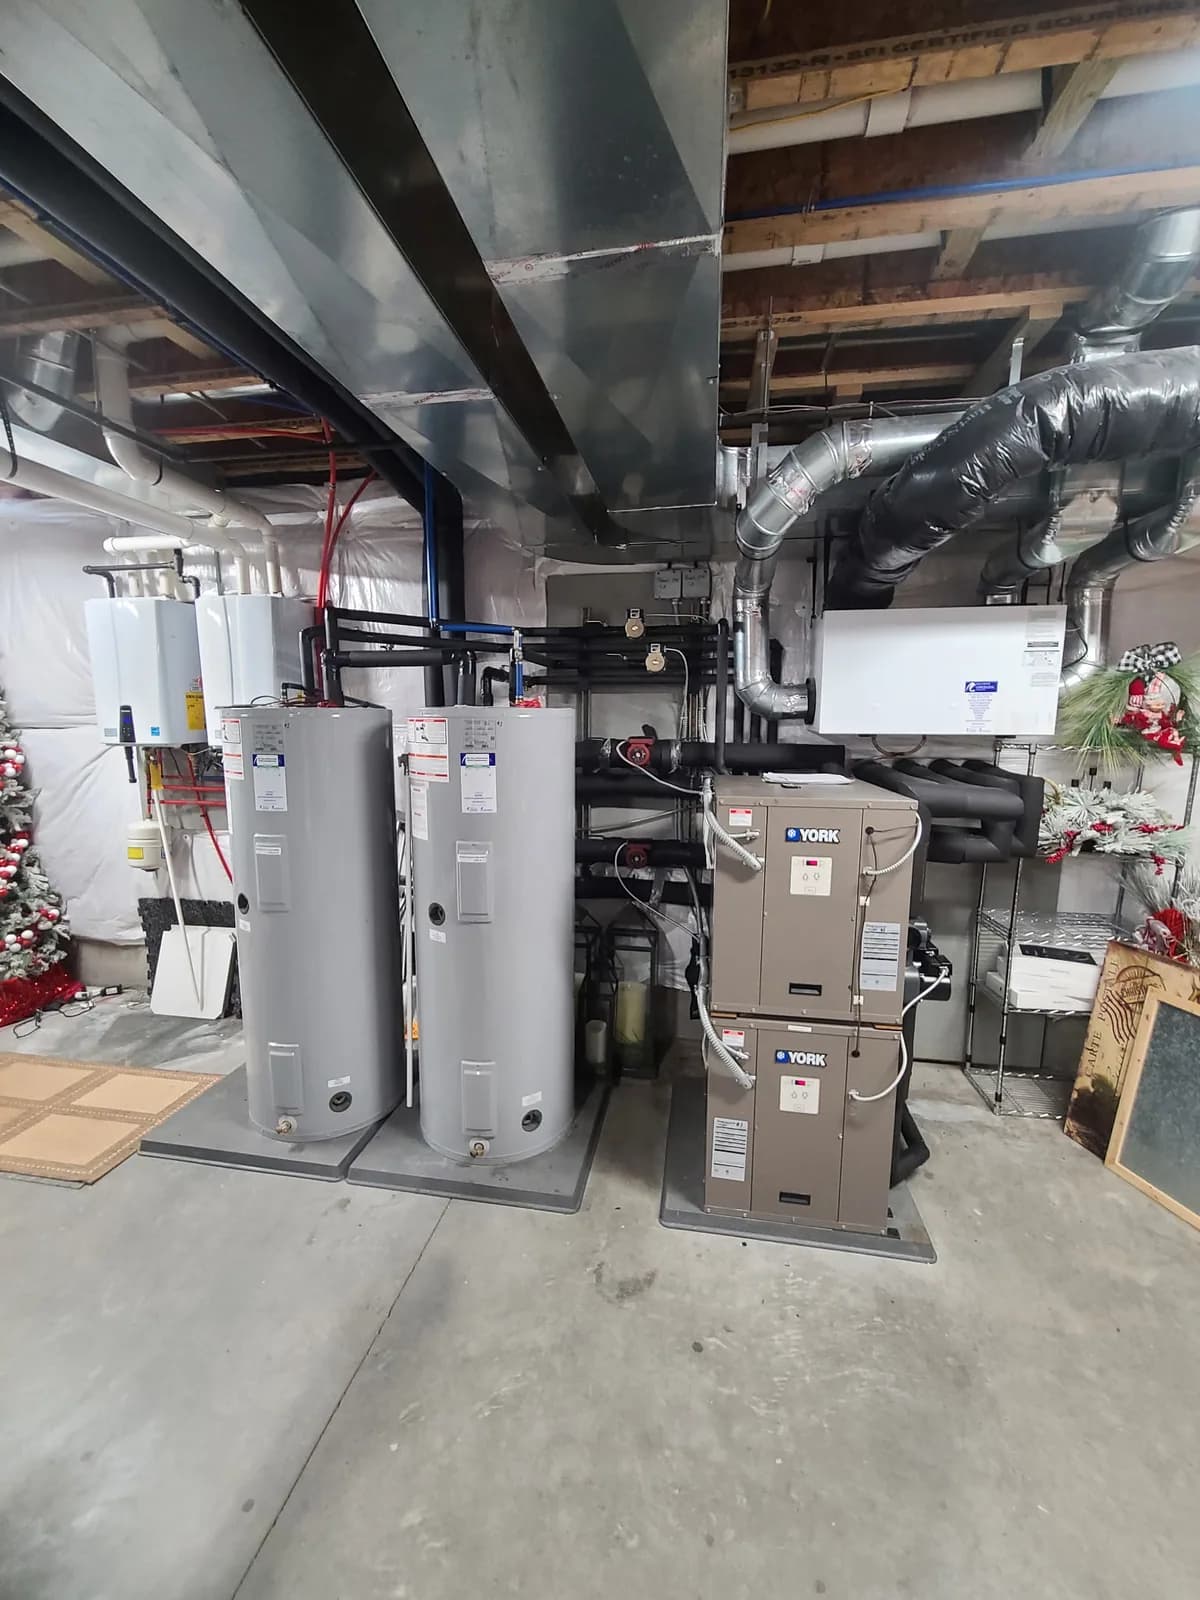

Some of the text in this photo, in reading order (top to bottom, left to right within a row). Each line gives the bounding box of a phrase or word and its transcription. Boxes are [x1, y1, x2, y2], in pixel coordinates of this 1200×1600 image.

[799, 828, 840, 843] YORK
[788, 1051, 827, 1067] YORK
[1086, 1031, 1103, 1078] CARTE
